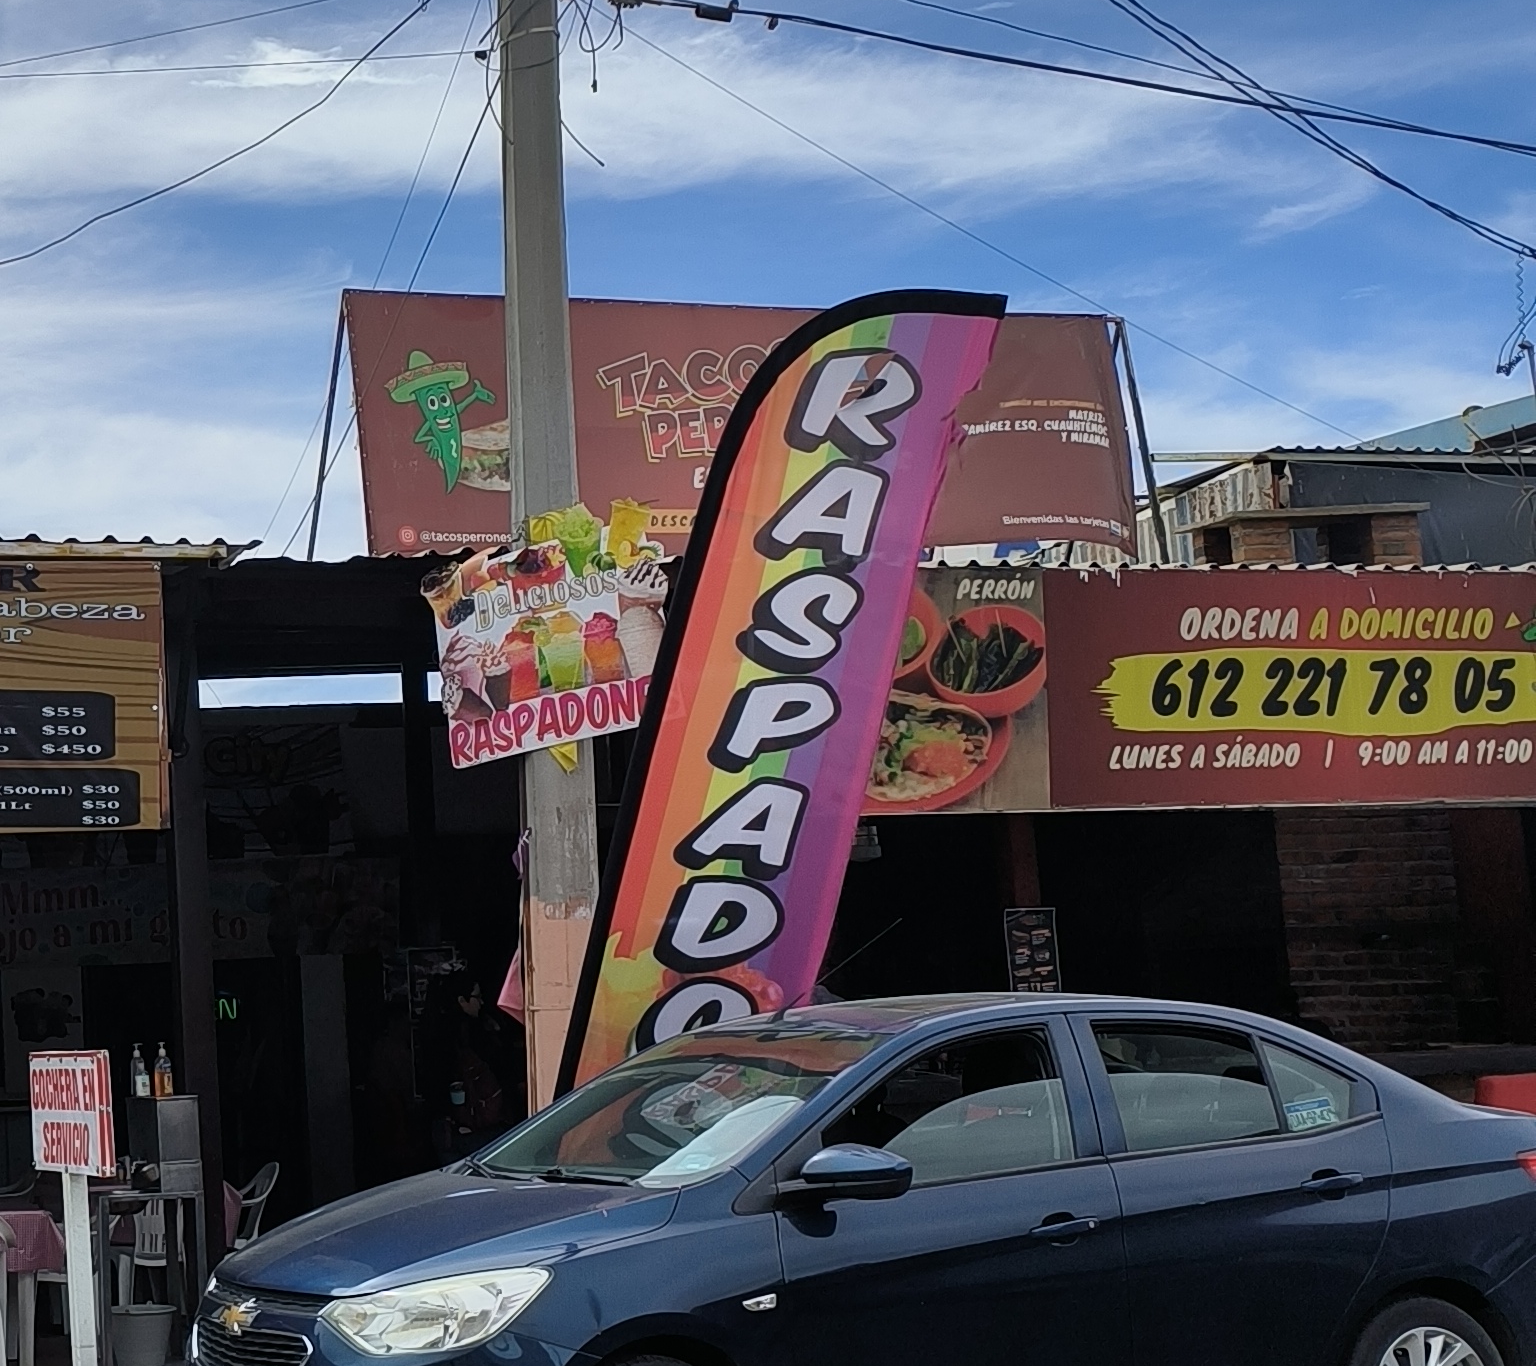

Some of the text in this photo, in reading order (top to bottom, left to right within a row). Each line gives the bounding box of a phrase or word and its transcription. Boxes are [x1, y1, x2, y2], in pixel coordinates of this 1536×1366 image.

[596, 338, 784, 418] TACO
[1015, 420, 1041, 431] ESQ.
[1061, 432, 1068, 442] Y
[1080, 516, 1110, 528] tarjetas
[420, 531, 512, 543] @tacosperrones
[957, 575, 1035, 601] PERRÓN
[1181, 607, 1493, 641] ORDENA A DOMICILIO
[1152, 656, 1515, 718] 612 221 78 05
[41, 705, 86, 719] $55
[41, 724, 87, 738] $50
[41, 742, 102, 756] $450
[1108, 736, 1533, 771] LUNES A SÁBADO 9:00 AM A 11:00
[82, 784, 121, 795] $30
[82, 799, 121, 810] $50
[82, 814, 121, 826] $30
[54, 924, 72, 948] a
[89, 915, 132, 944] mi
[150, 909, 247, 947] gto
[31, 1068, 80, 1110] COCHERA
[82, 1068, 96, 1112] EN
[42, 1122, 90, 1166] SERVICIO
